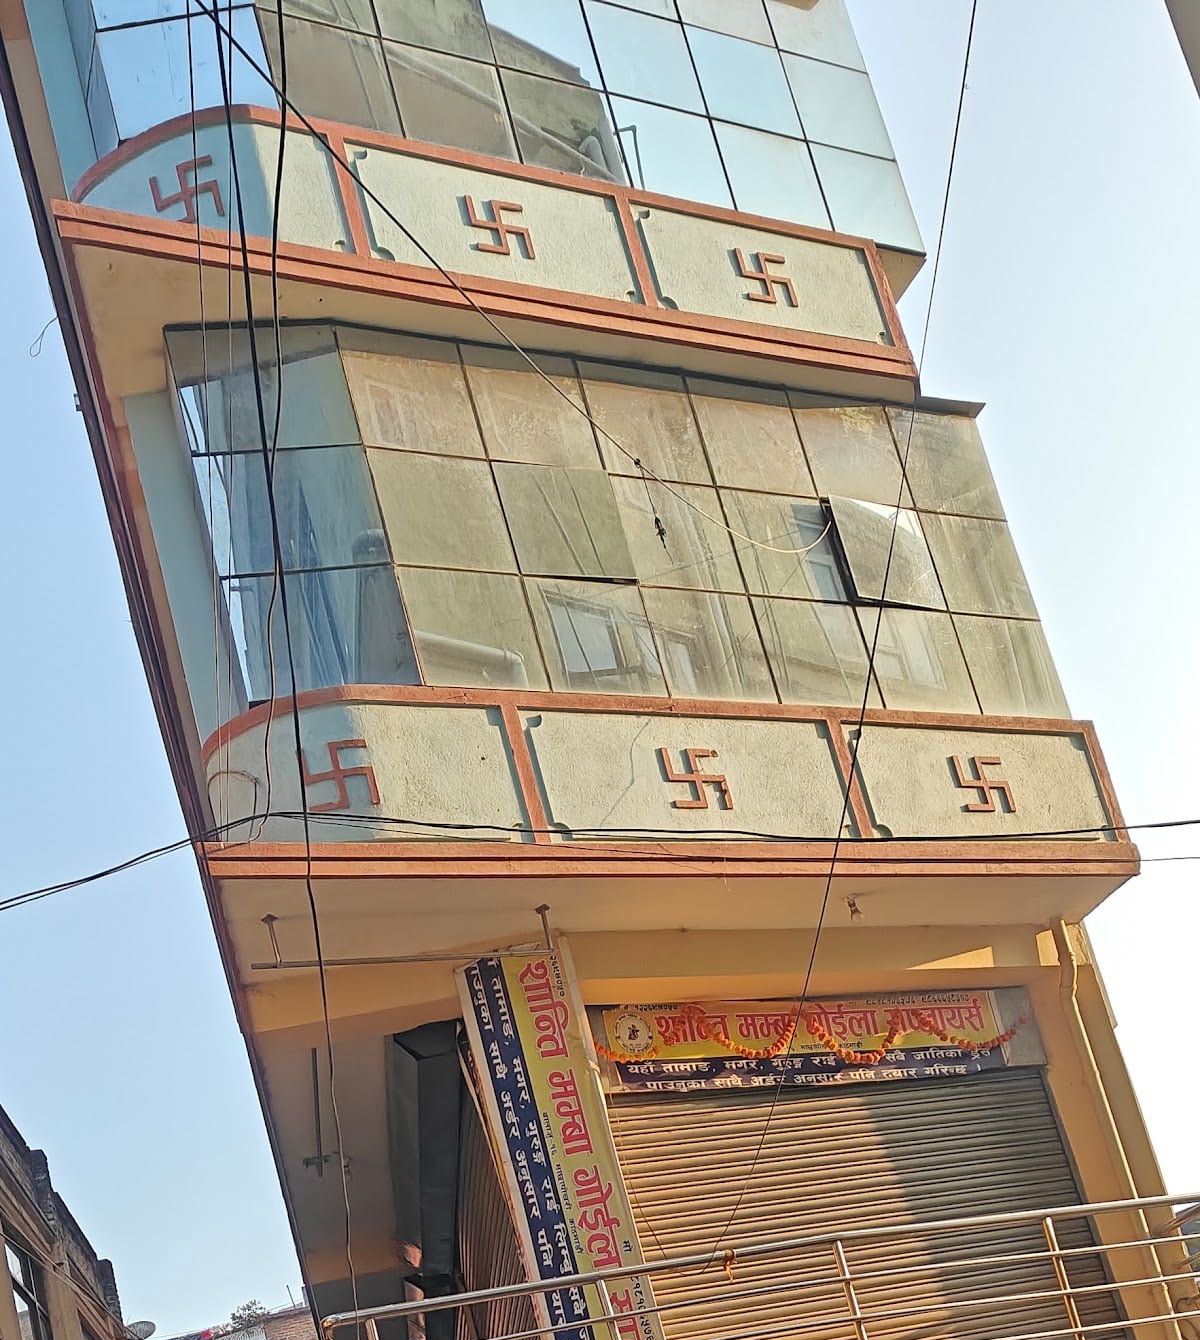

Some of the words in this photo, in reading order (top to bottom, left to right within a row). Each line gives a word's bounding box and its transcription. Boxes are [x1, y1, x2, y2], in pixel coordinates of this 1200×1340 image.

[736, 1012, 798, 1040] मम्ब
[627, 1060, 656, 1074] यहाँ
[812, 1052, 837, 1067] राई
[912, 1046, 963, 1061] जातिका
[645, 1078, 706, 1092] पाउनुका
[849, 1066, 877, 1081] पनि
[923, 1062, 968, 1077] गरिन्छ
[519, 960, 570, 1058] शान्ति
[549, 1069, 593, 1156] मम्बा
[574, 1166, 623, 1269] गोईल
[489, 1041, 507, 1079] साथै
[501, 1091, 520, 1139] अर्डर
[516, 1150, 541, 1218] अनुसार
[538, 1228, 553, 1267] पनि
[542, 1176, 560, 1213] राई
